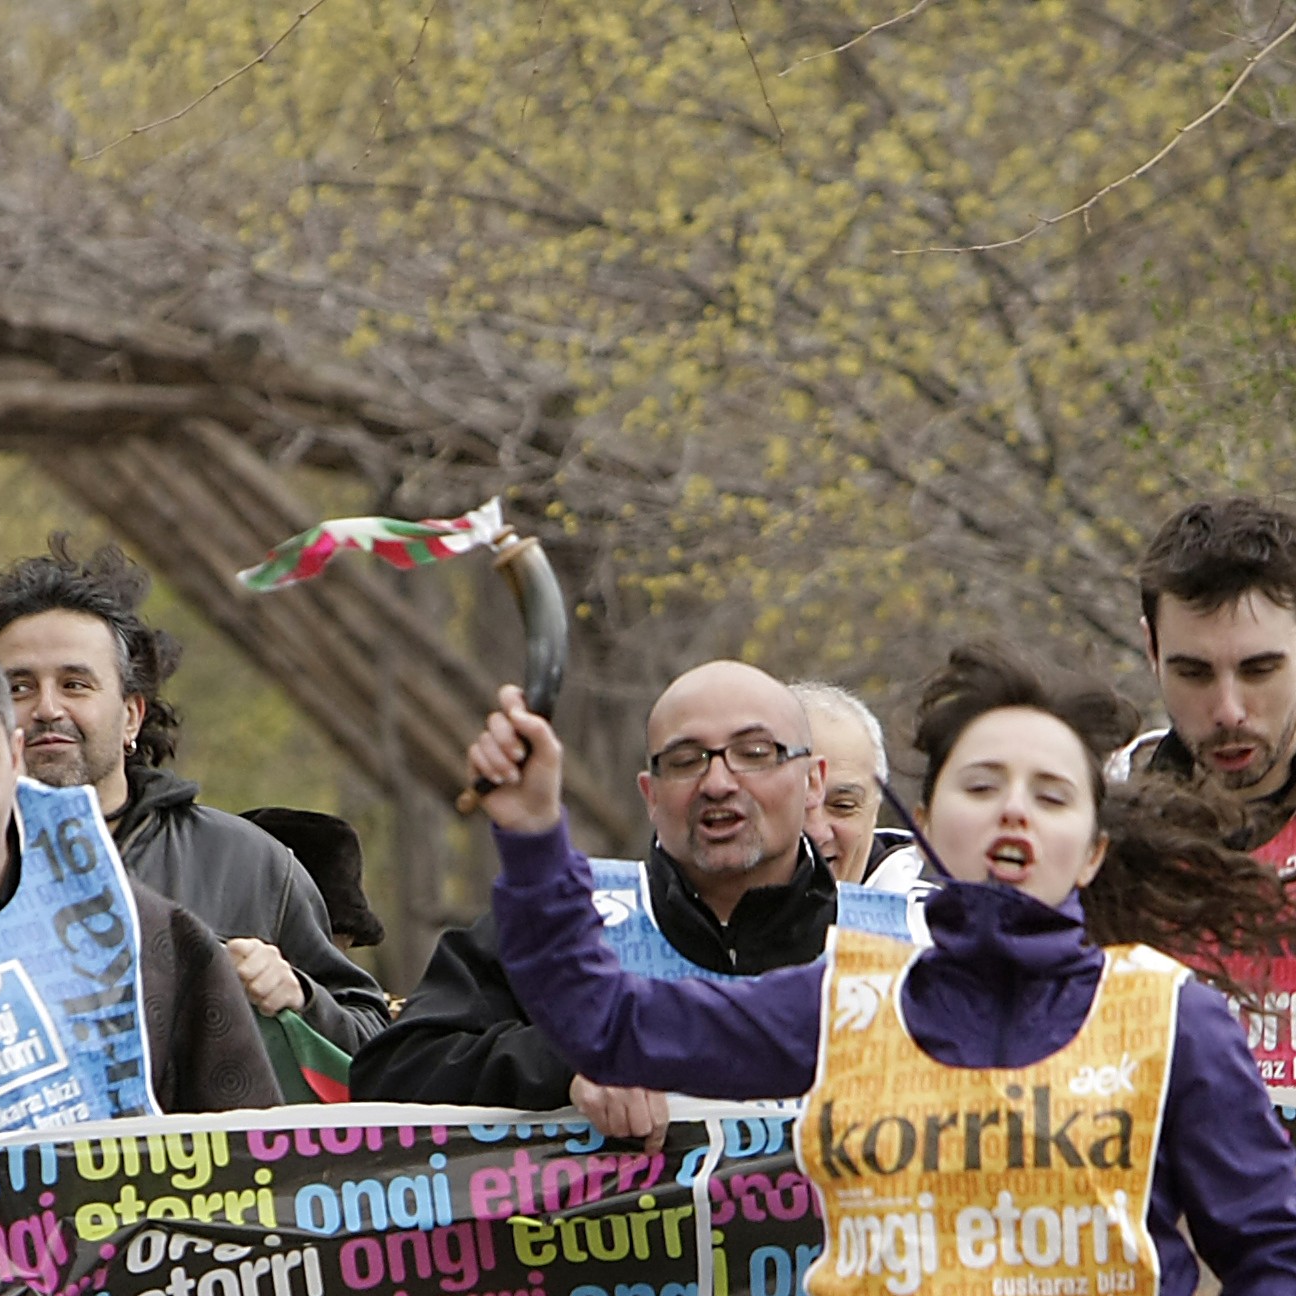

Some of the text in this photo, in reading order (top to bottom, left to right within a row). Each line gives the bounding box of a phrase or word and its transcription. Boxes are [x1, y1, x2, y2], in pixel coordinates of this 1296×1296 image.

[31, 817, 99, 884] 16
[1069, 1052, 1139, 1096] aek
[817, 1084, 1133, 1181] korrika
[75, 1168, 275, 1241] etorri
[295, 1153, 451, 1234] ongi
[339, 1216, 496, 1292] ongi
[836, 1190, 938, 1296] ongi
[955, 1189, 1139, 1269] etorri
[992, 1269, 1135, 1296] euskaraz bizi
